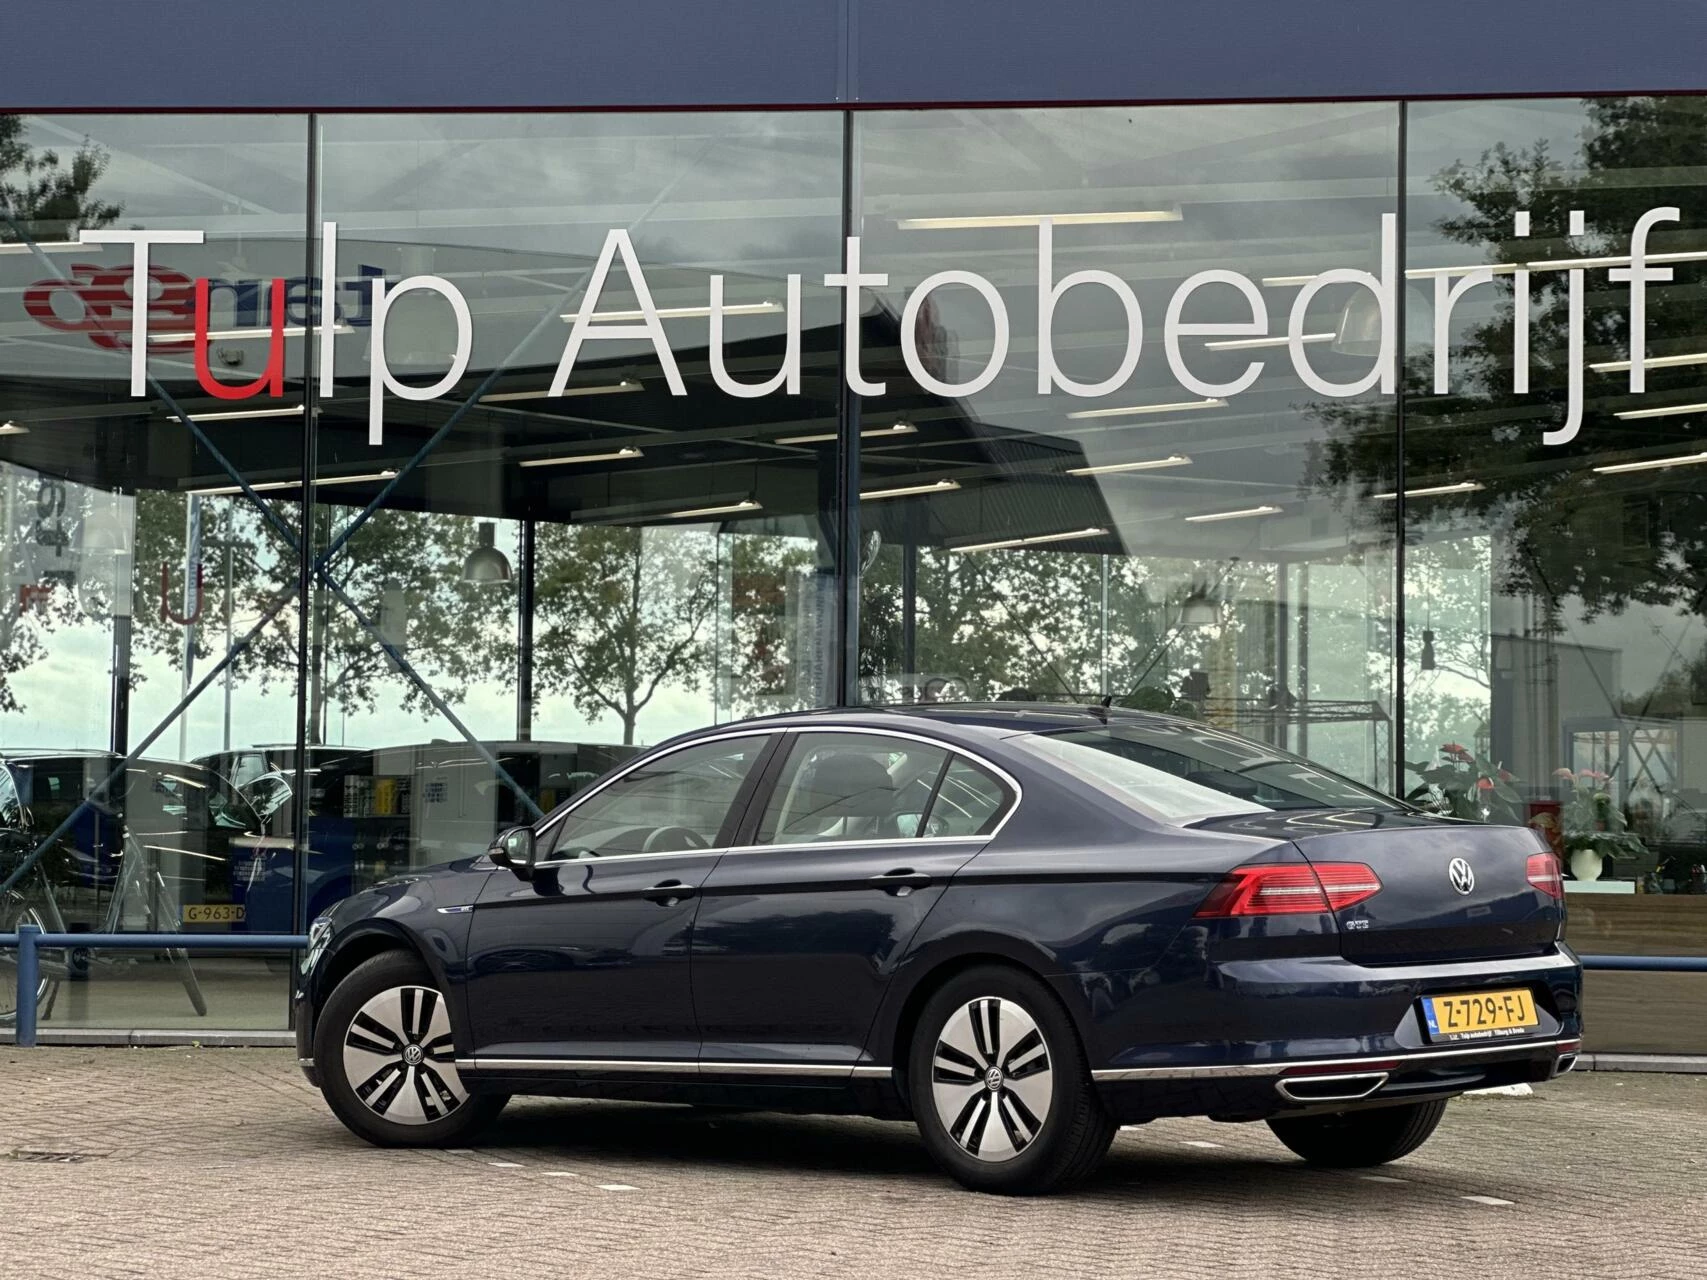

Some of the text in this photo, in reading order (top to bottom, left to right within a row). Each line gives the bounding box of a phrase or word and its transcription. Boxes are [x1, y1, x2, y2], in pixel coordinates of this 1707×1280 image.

[79, 206, 1680, 446] Tulp Autobedrijf
[188, 906, 246, 920] G-963-D
[1443, 994, 1525, 1028] Z-729-FJ
[1428, 1018, 1438, 1029] NL
